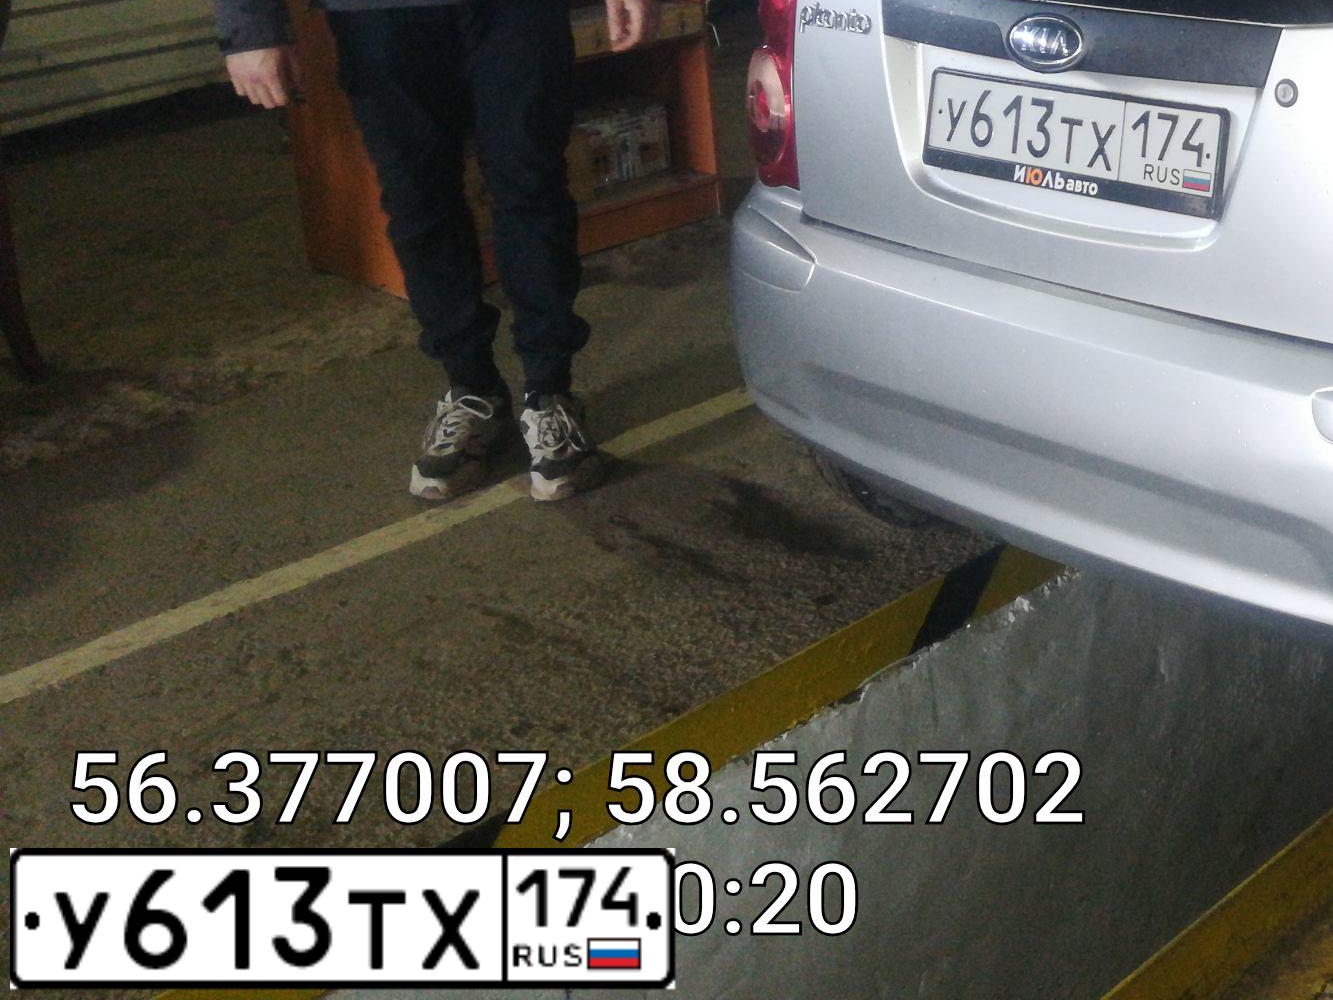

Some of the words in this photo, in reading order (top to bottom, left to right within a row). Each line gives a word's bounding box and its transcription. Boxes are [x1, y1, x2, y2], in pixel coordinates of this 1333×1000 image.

[946, 89, 1117, 172] У613ТХ
[1131, 110, 1204, 167] 174
[1143, 163, 1180, 186] RUS
